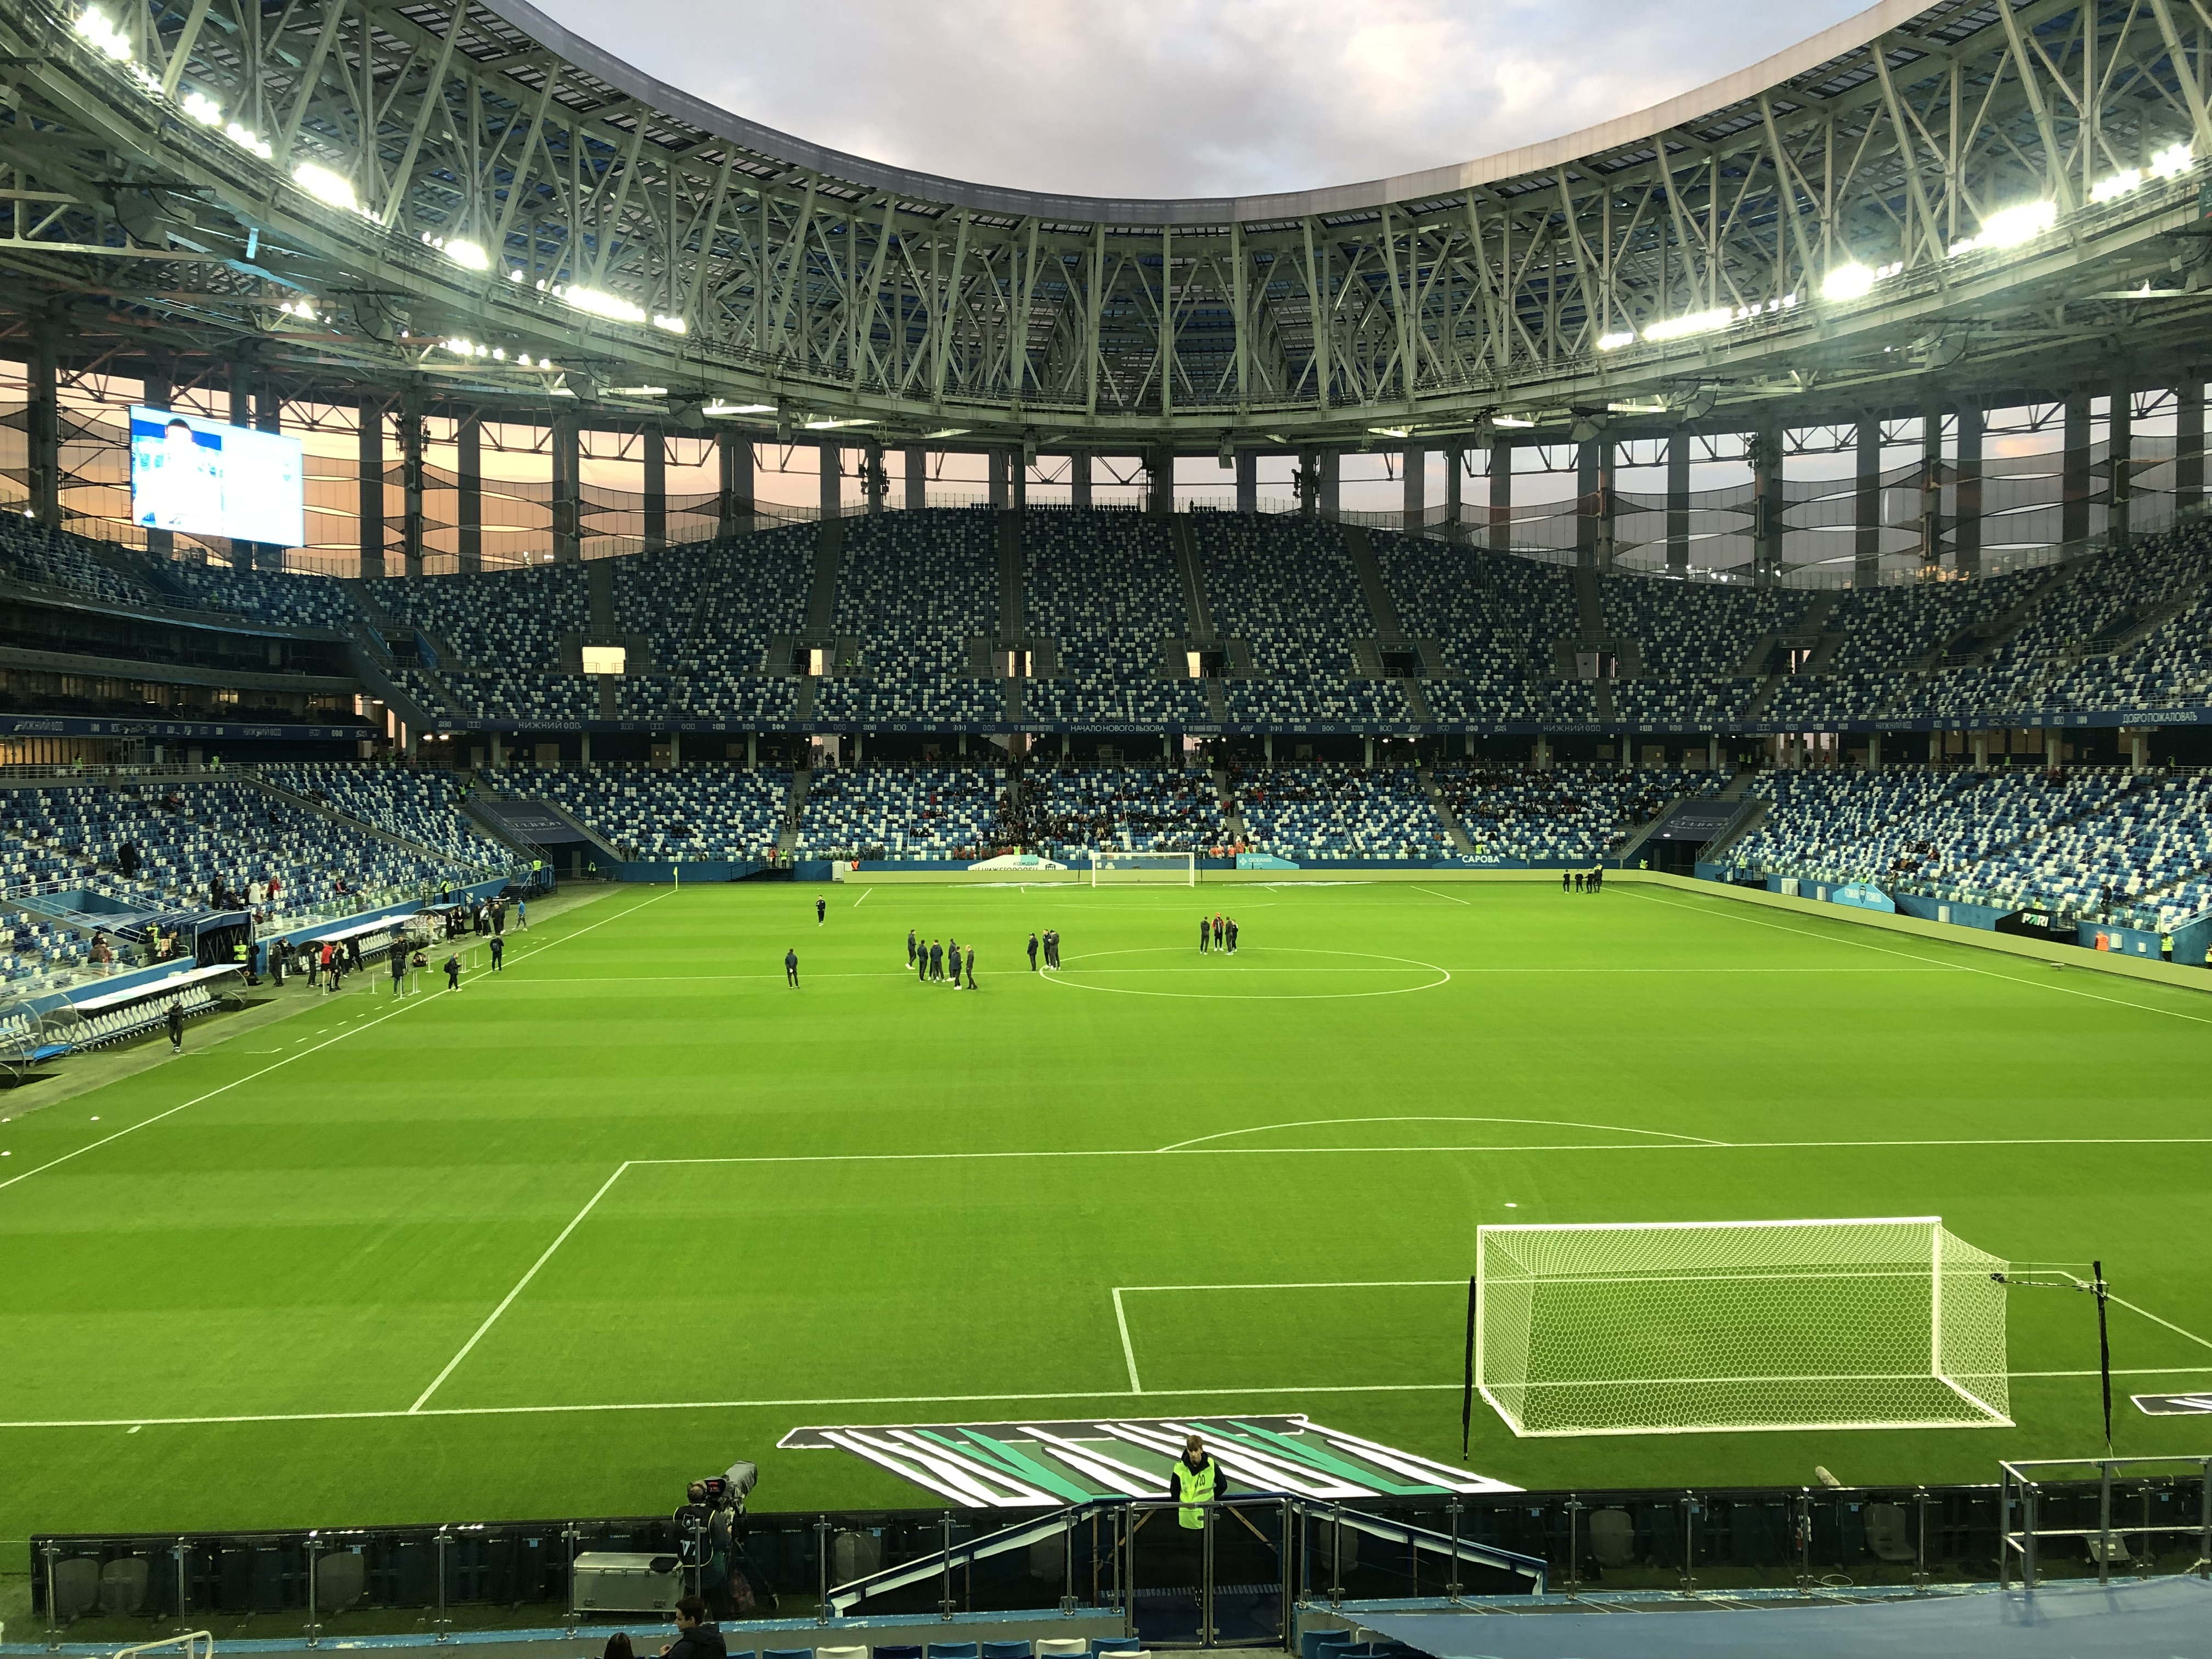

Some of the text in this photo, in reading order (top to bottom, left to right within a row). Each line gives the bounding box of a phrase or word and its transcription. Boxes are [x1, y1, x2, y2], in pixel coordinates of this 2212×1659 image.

[2123, 712, 2198, 724] ДОБРО ПОЖАЛОВАТЬ
[518, 720, 562, 729] НИЖНИЙ
[1543, 724, 1584, 732] НИЖНИЙ
[1462, 855, 1500, 864] САРОВА
[2021, 913, 2049, 927] PARI
